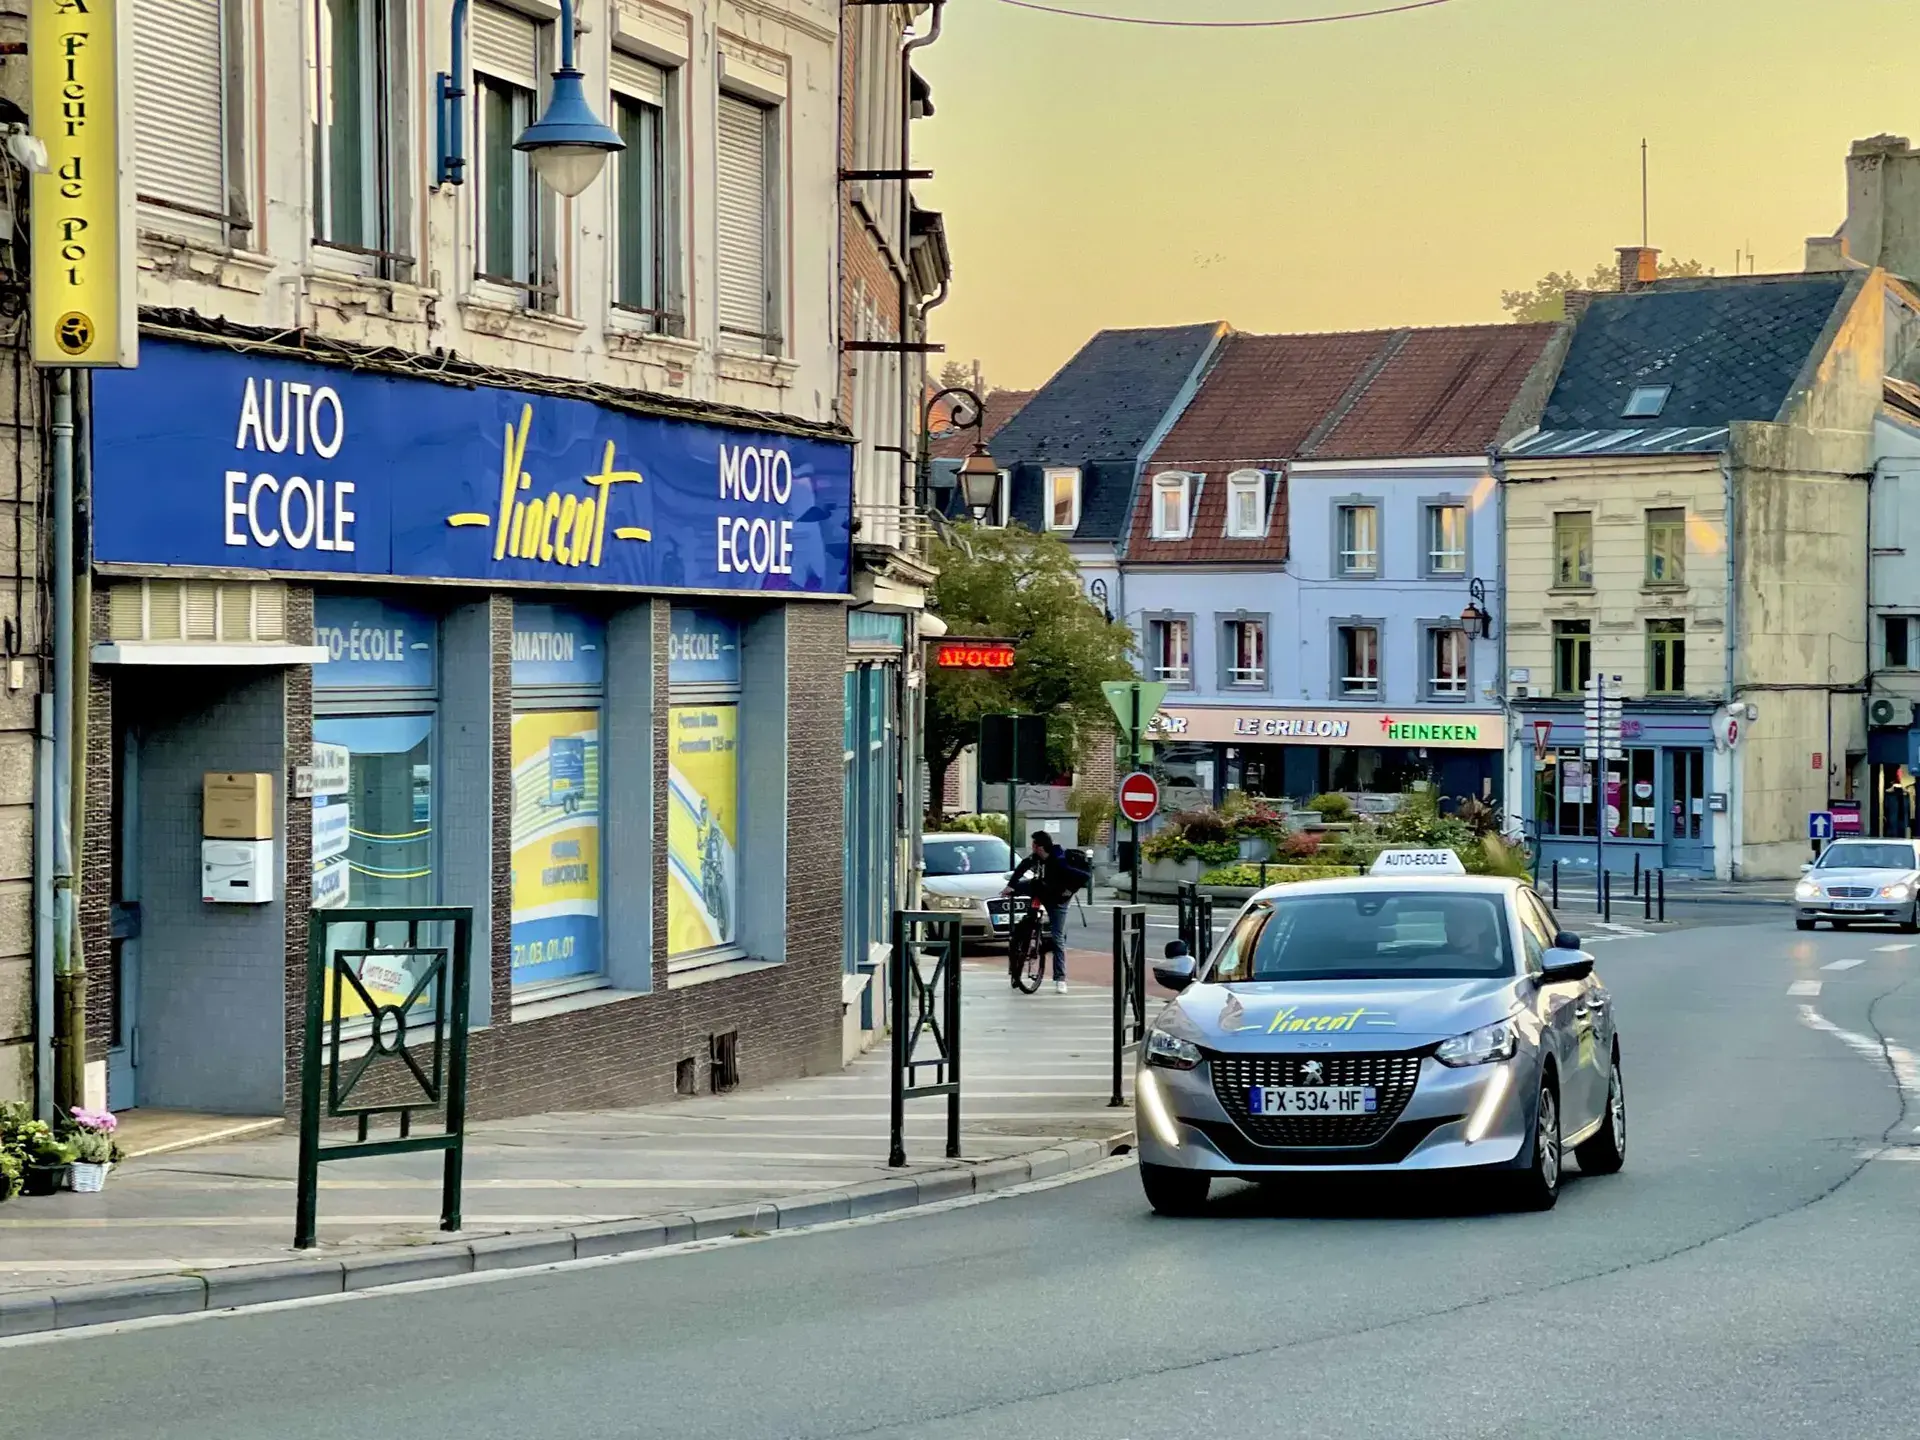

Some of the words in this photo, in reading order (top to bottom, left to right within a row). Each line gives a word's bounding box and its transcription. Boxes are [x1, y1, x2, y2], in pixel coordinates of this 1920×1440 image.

[58, 32, 89, 137] Fleur
[58, 157, 83, 199] de
[57, 217, 89, 286] Pot
[235, 377, 345, 459] AUTO
[493, 402, 644, 568] Vincent
[718, 443, 793, 505] MOTO
[224, 470, 356, 552] ECOLE
[717, 516, 794, 575] ECOLE
[1234, 718, 1260, 735] LE
[1263, 719, 1350, 737] GRILLON
[1389, 723, 1478, 741] HEINEKEN
[1385, 853, 1448, 866] AUTO-ECOLE
[1266, 1006, 1389, 1034] Vincent
[1264, 1090, 1362, 1112] FX-534-HF
